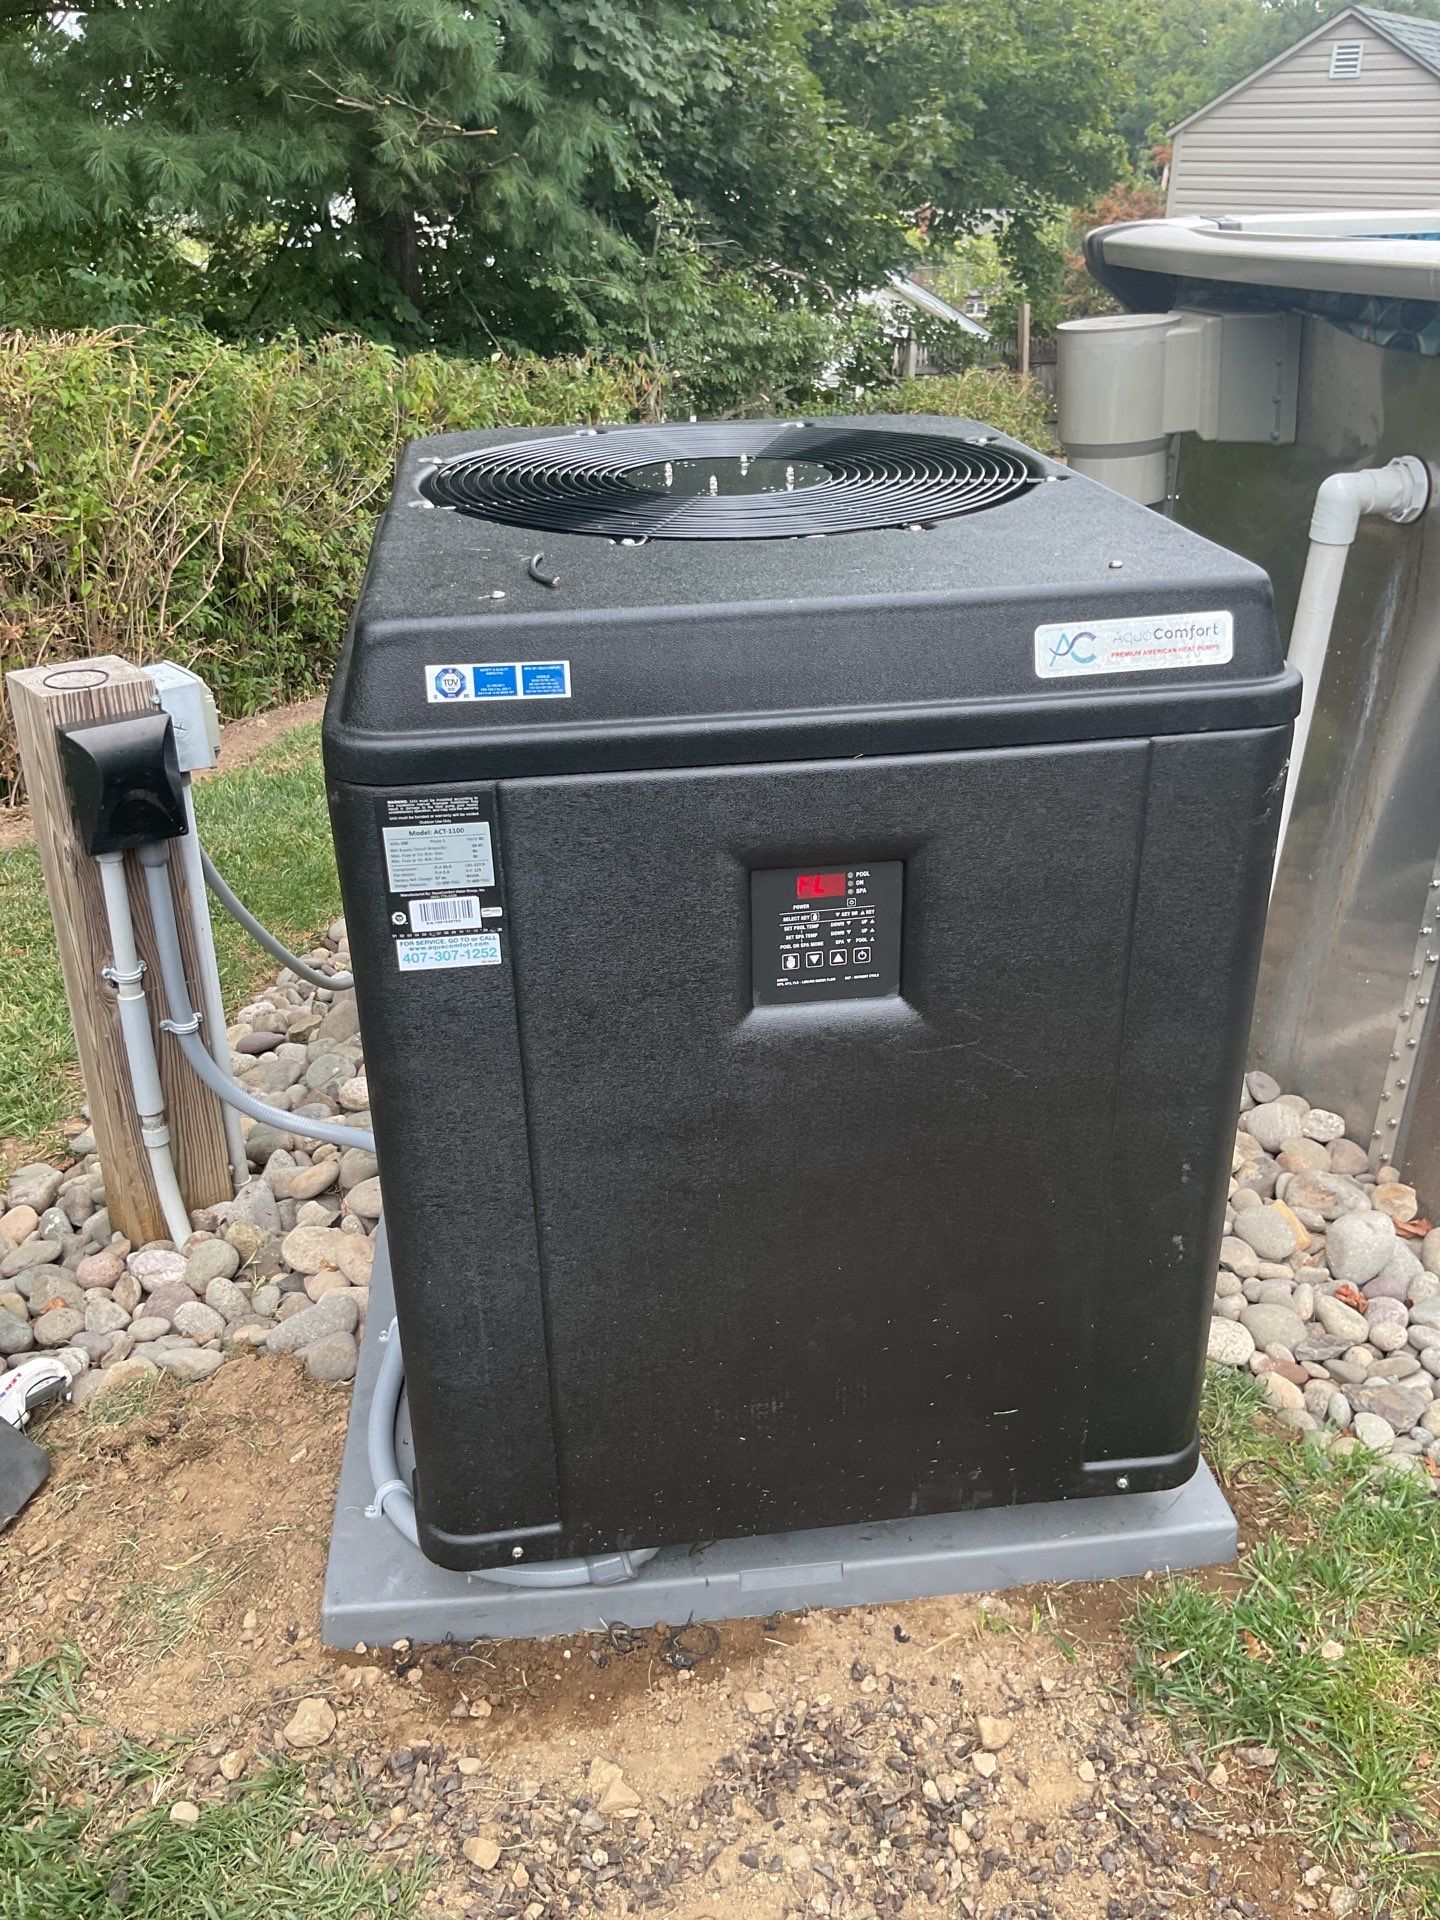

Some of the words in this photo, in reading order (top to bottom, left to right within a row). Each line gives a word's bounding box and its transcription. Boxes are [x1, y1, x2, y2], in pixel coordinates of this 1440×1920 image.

[1112, 623, 1218, 645] AquaComfort
[1111, 650, 1141, 658] PREMIUM
[1143, 647, 1177, 656] AMERICAN
[409, 942, 489, 951] www.aquacomfort.com
[403, 947, 498, 963] 407-307-1252
